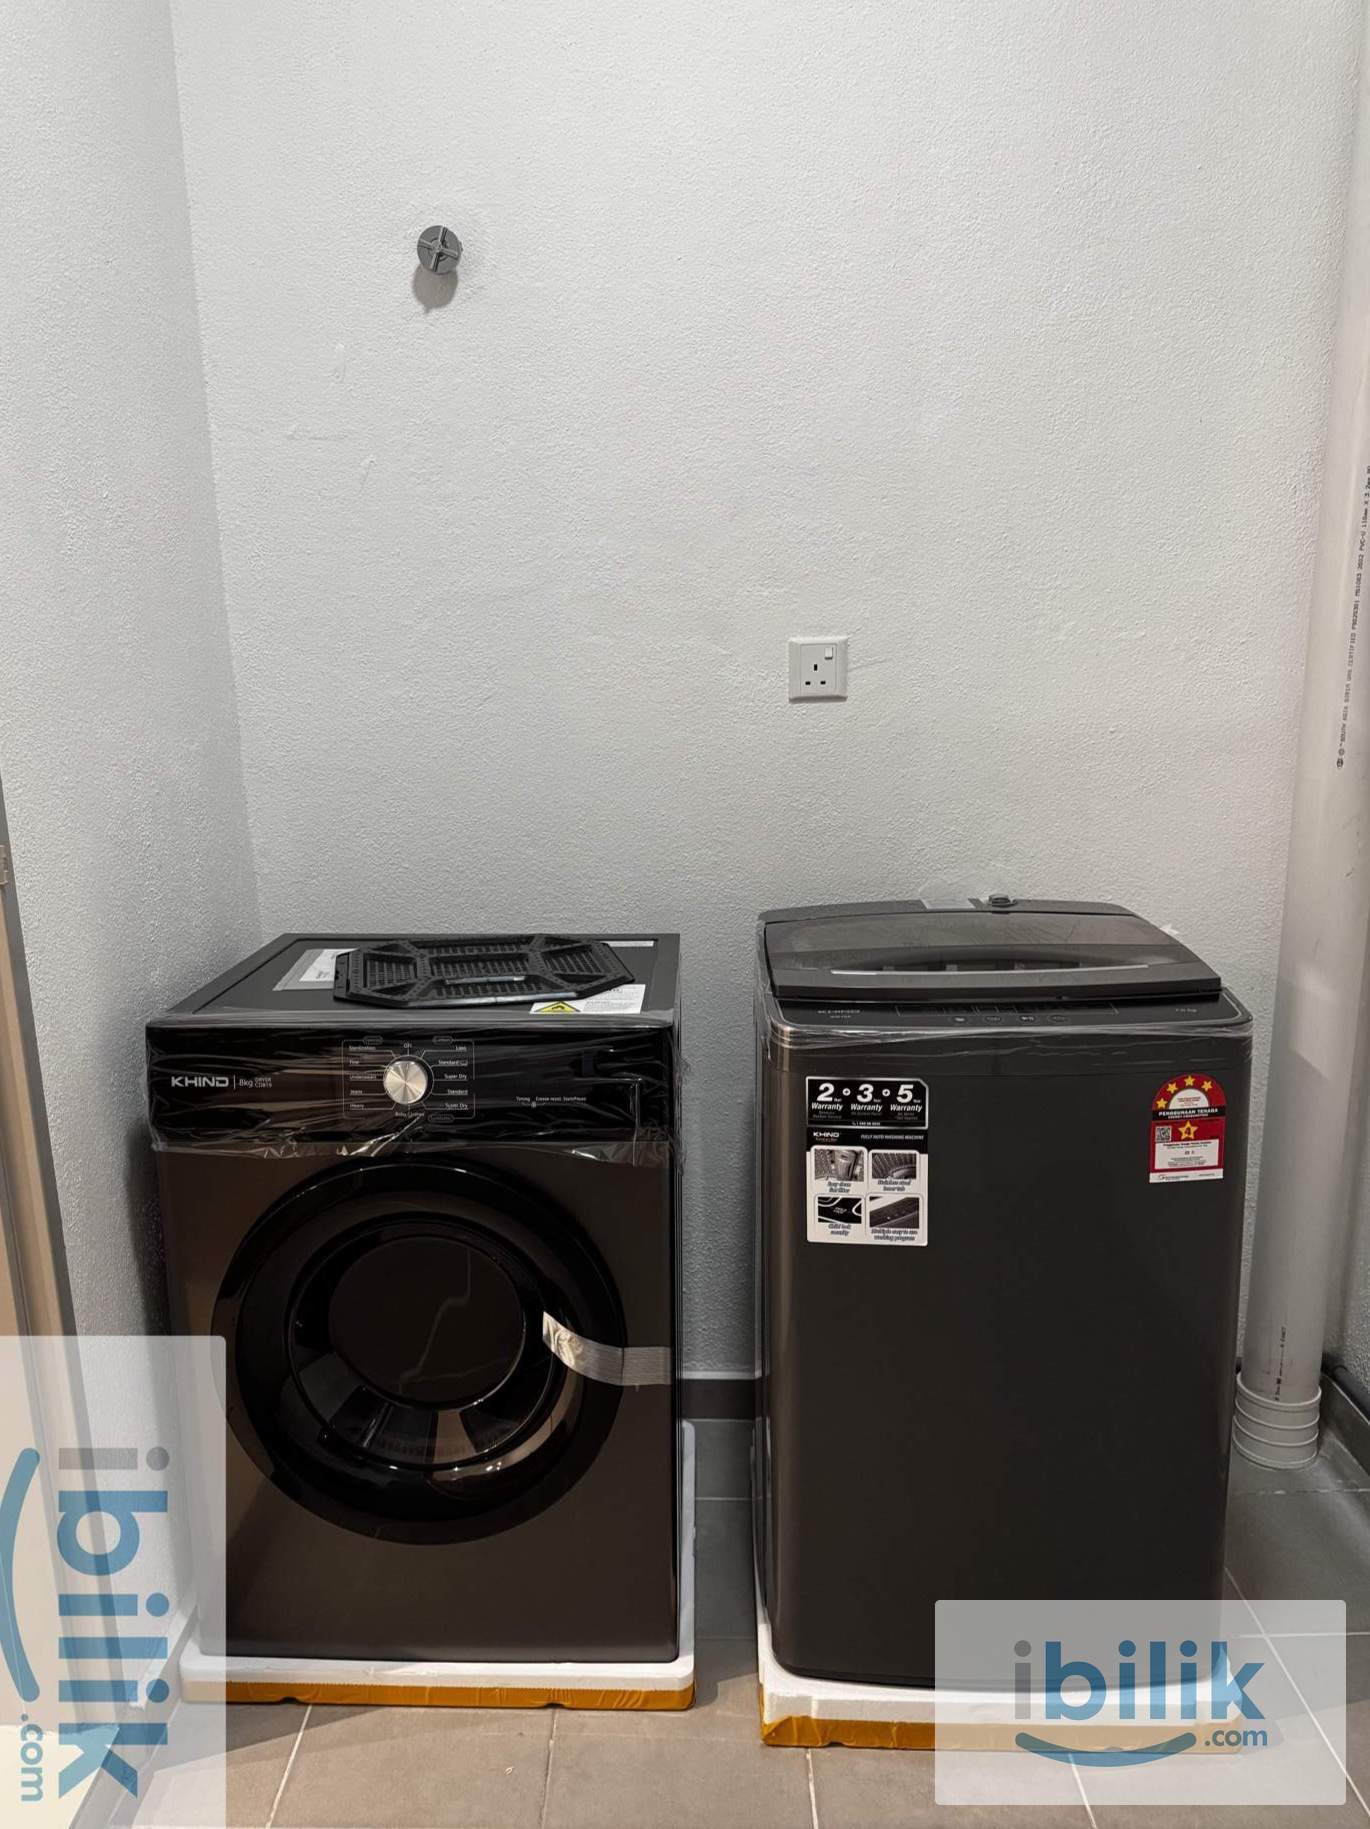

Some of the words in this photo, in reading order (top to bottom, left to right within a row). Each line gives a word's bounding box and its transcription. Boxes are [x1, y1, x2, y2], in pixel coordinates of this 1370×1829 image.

[171, 1076, 229, 1088] KHIND
[816, 1082, 835, 1102] 2
[856, 1083, 874, 1103] 3
[896, 1084, 914, 1104] 5
[811, 1102, 843, 1111] Warranty
[850, 1103, 882, 1112] Warranty
[890, 1104, 922, 1113] Warranty
